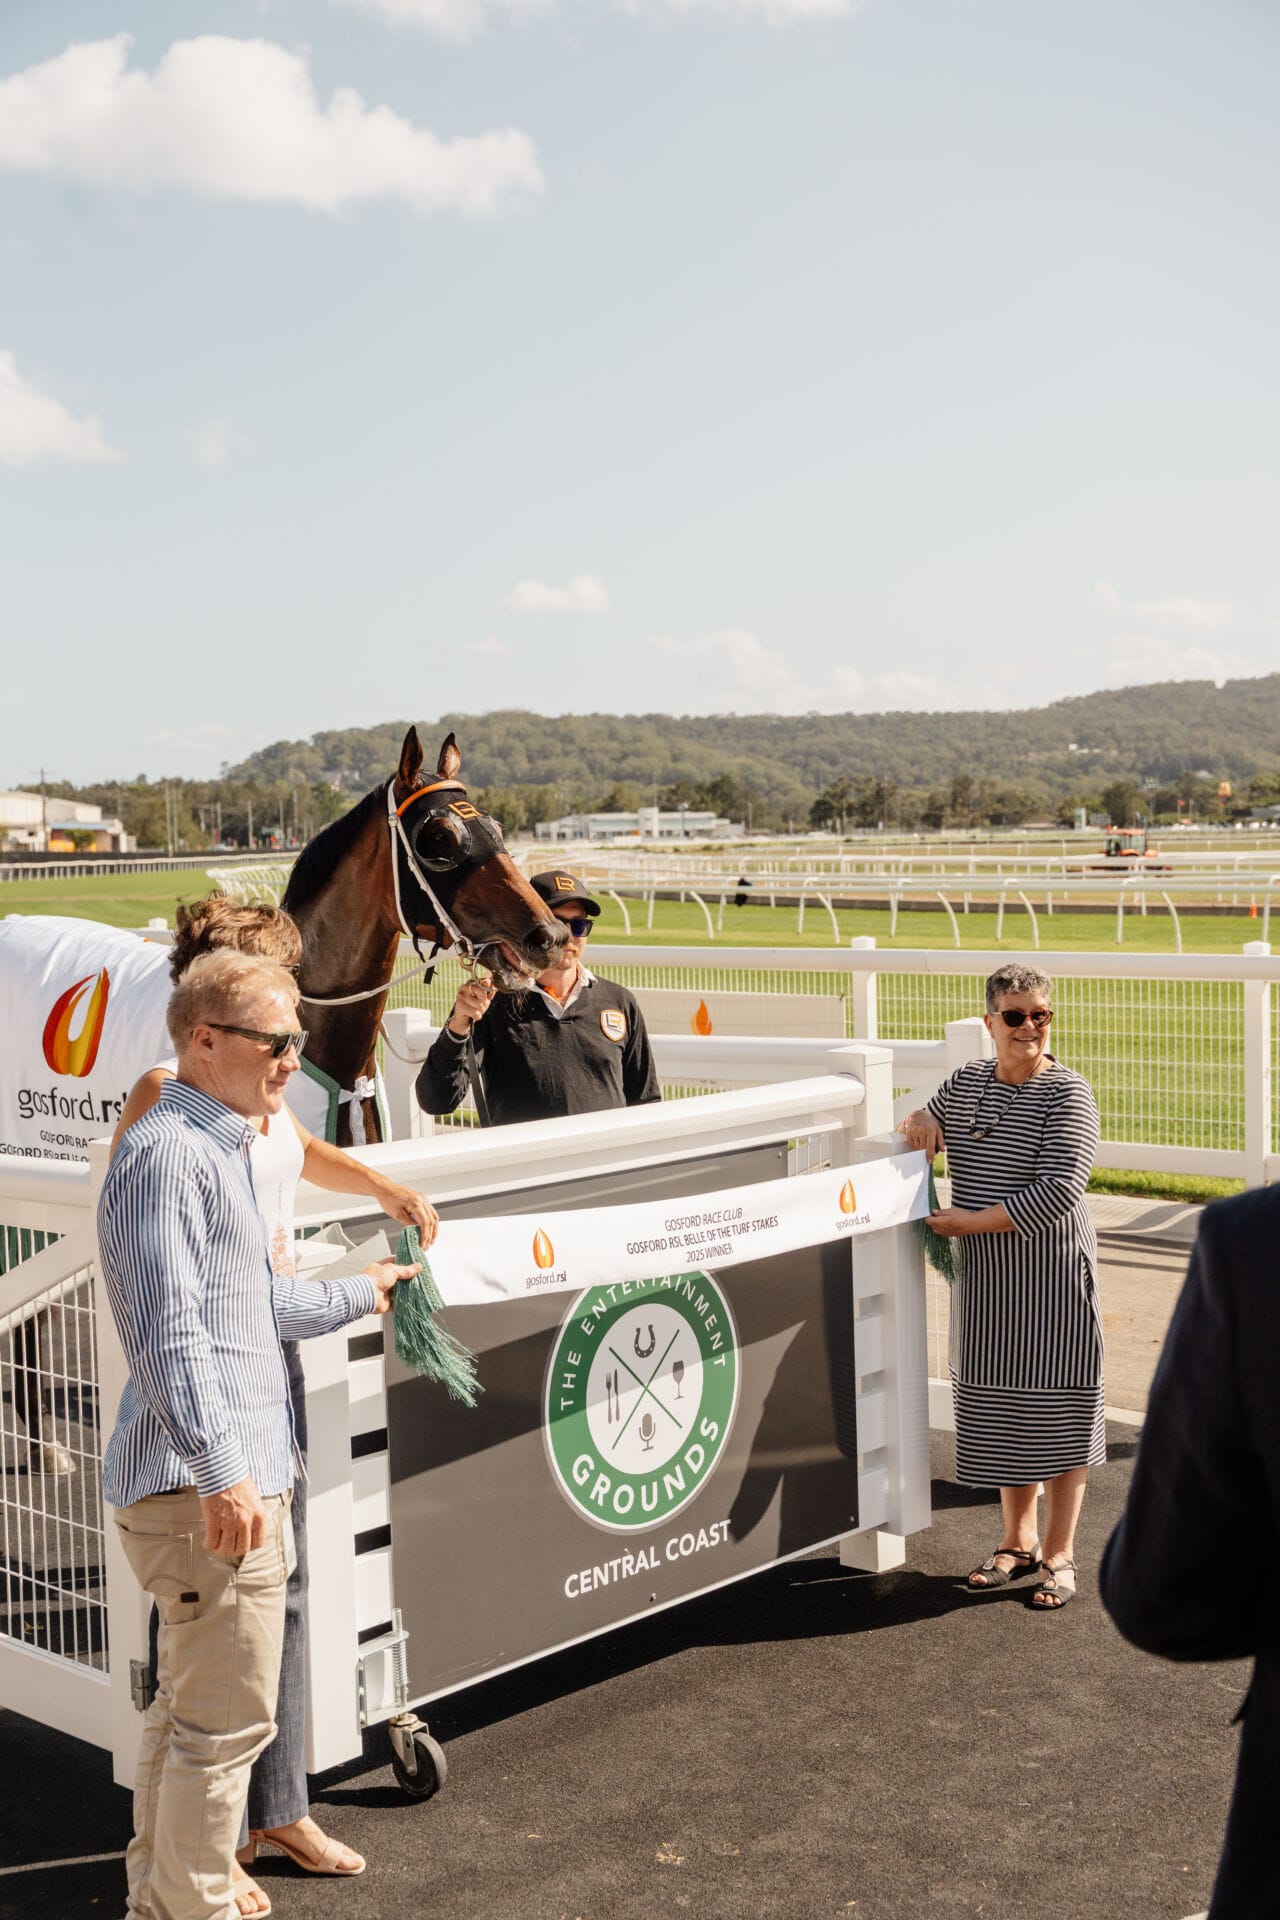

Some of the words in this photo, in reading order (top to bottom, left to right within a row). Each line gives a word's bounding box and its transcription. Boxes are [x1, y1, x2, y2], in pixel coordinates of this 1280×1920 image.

[626, 1238, 668, 1255] GOSFORD
[669, 1235, 684, 1249] RSL
[683, 1231, 707, 1246] BELLE
[706, 1230, 717, 1242] OF
[717, 1226, 732, 1240] THE
[732, 1221, 751, 1236] TURF
[751, 1215, 779, 1232] STAKES
[664, 1215, 701, 1232] GOSFORD
[702, 1211, 722, 1226] RACE
[723, 1207, 743, 1222] CLUB
[836, 1213, 870, 1231] gosford.rsl
[686, 1250, 705, 1263] 2025
[705, 1242, 734, 1260] WINNER
[526, 1270, 567, 1289] gosford.rsl
[560, 1350, 582, 1411] THE
[572, 1416, 719, 1514] GROUNDS
[564, 1546, 661, 1598] CENTRAL
[665, 1519, 731, 1561] COAST
